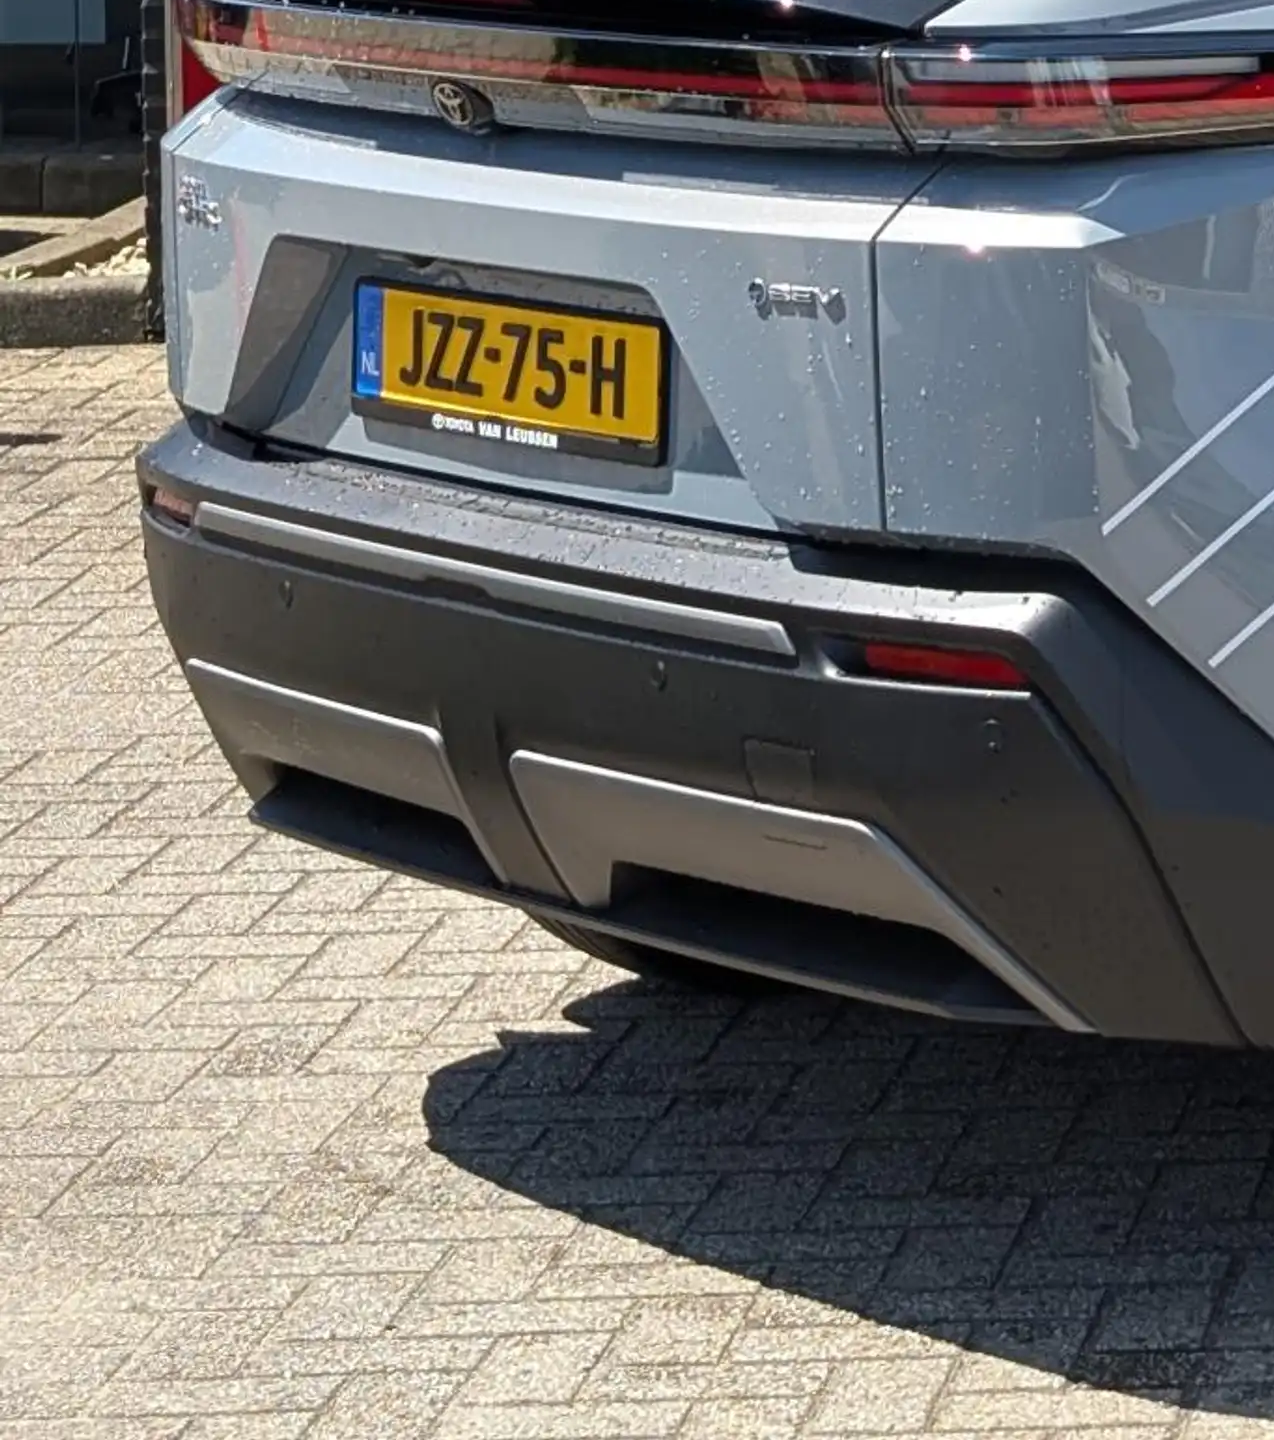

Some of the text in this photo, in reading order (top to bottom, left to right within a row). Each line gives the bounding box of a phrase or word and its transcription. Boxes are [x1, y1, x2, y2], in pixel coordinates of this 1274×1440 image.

[361, 350, 380, 377] NL
[399, 308, 627, 420] JZZ-75-H
[478, 420, 502, 439] VAN
